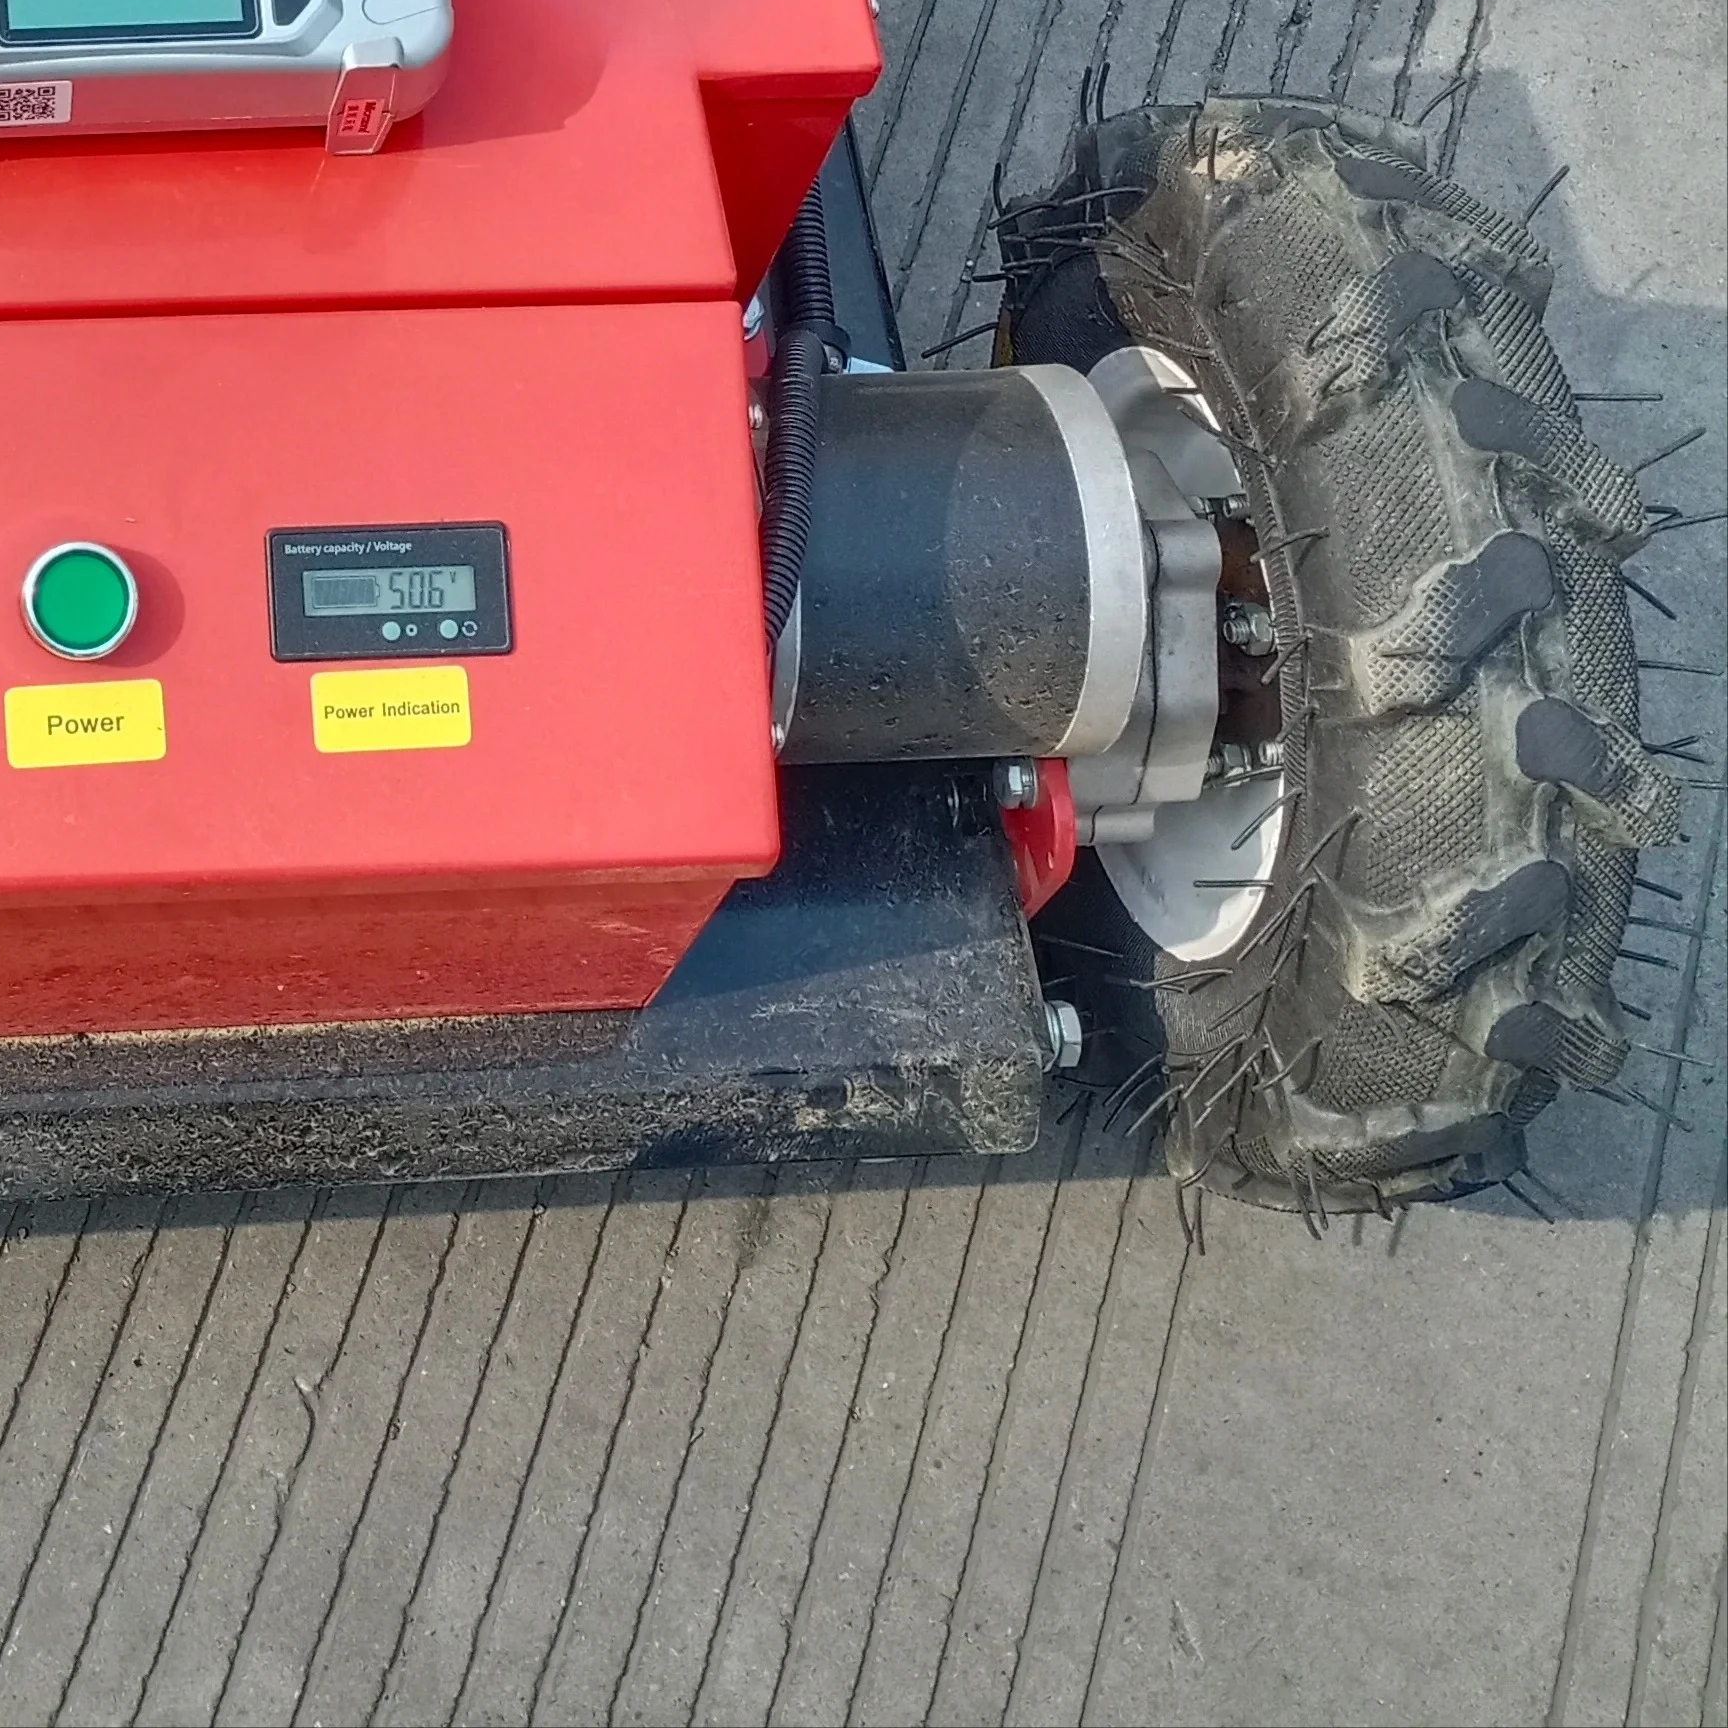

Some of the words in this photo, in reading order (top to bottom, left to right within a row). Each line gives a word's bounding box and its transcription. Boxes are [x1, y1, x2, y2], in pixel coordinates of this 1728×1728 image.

[284, 544, 322, 556] Battery
[323, 542, 365, 556] capacity
[373, 540, 412, 553] Voltage
[324, 703, 375, 720] Power
[382, 700, 461, 717] Indication
[47, 712, 125, 736] Power
